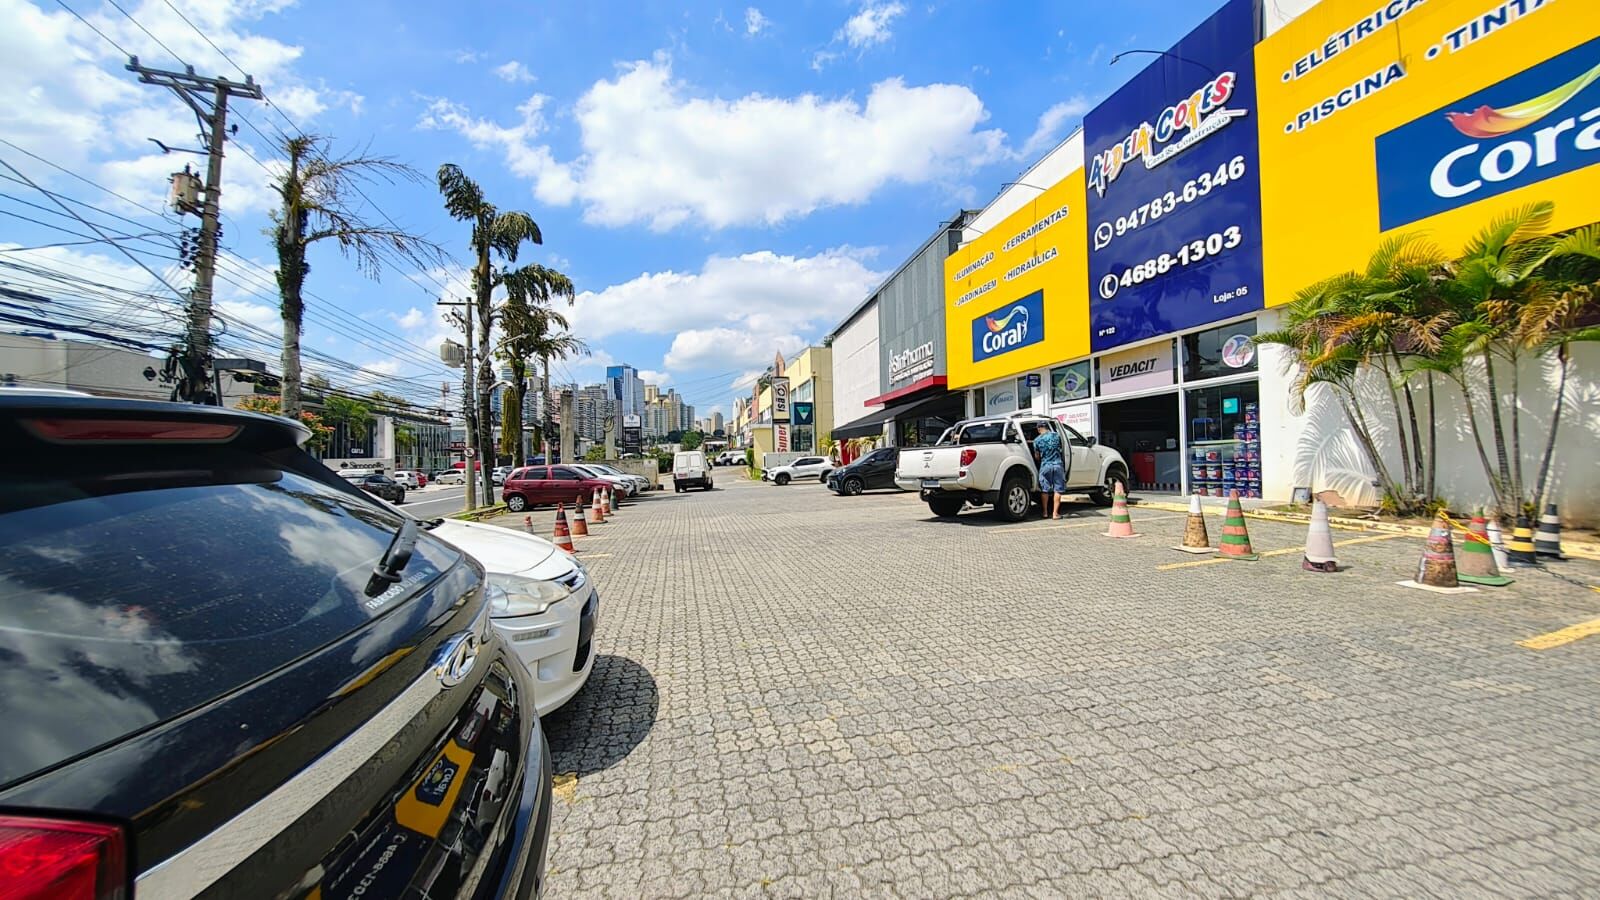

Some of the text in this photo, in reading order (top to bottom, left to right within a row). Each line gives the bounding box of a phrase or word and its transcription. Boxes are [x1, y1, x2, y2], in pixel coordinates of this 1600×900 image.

[1297, 63, 1404, 129] PISCINA
[1088, 123, 1153, 194] ALDEIA
[1115, 155, 1245, 236] 94783-6346
[1006, 207, 1068, 250] FERRAMENTAS
[956, 252, 994, 281] ILUMINAÇÃO
[1120, 226, 1242, 287] 4688-1303
[957, 279, 997, 306] JARDINAGEM
[1213, 287, 1248, 303] Loja: 05
[982, 322, 1022, 353] Coral
[1109, 358, 1157, 378] VEDACIT
